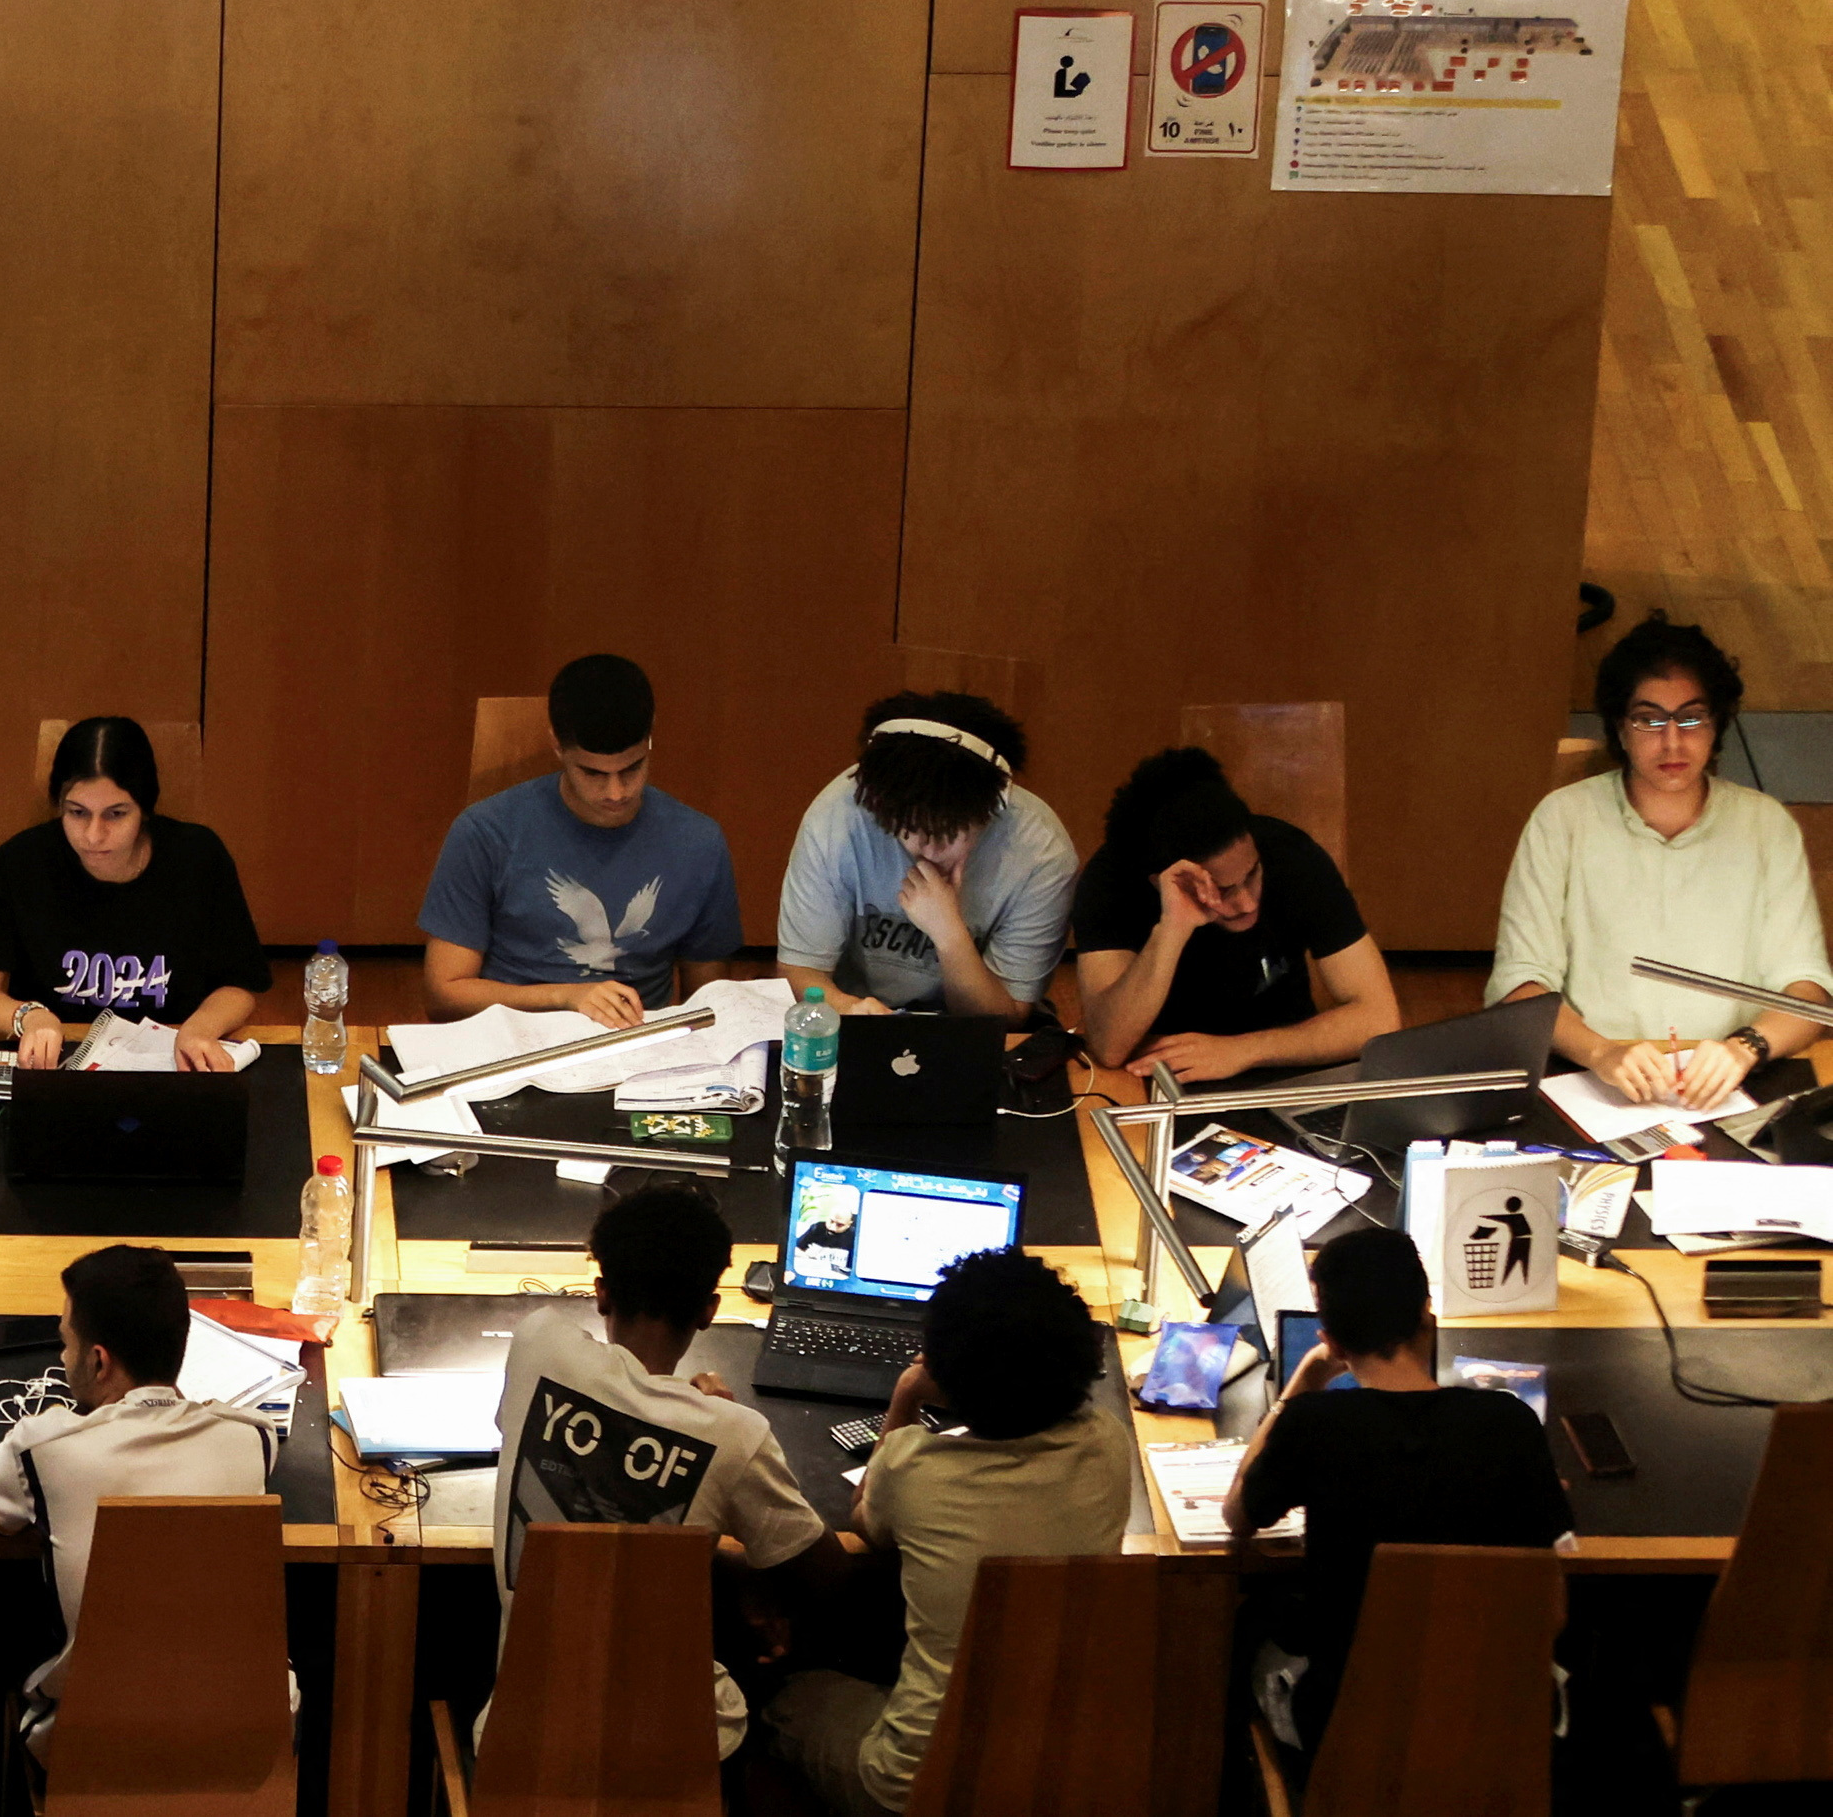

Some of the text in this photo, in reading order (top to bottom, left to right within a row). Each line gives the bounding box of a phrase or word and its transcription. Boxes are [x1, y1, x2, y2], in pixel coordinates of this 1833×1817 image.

[1158, 121, 1181, 138] 10
[861, 914, 937, 963] ESCAP
[60, 949, 168, 1009] 2024
[1589, 1191, 1616, 1231] PHYSICS
